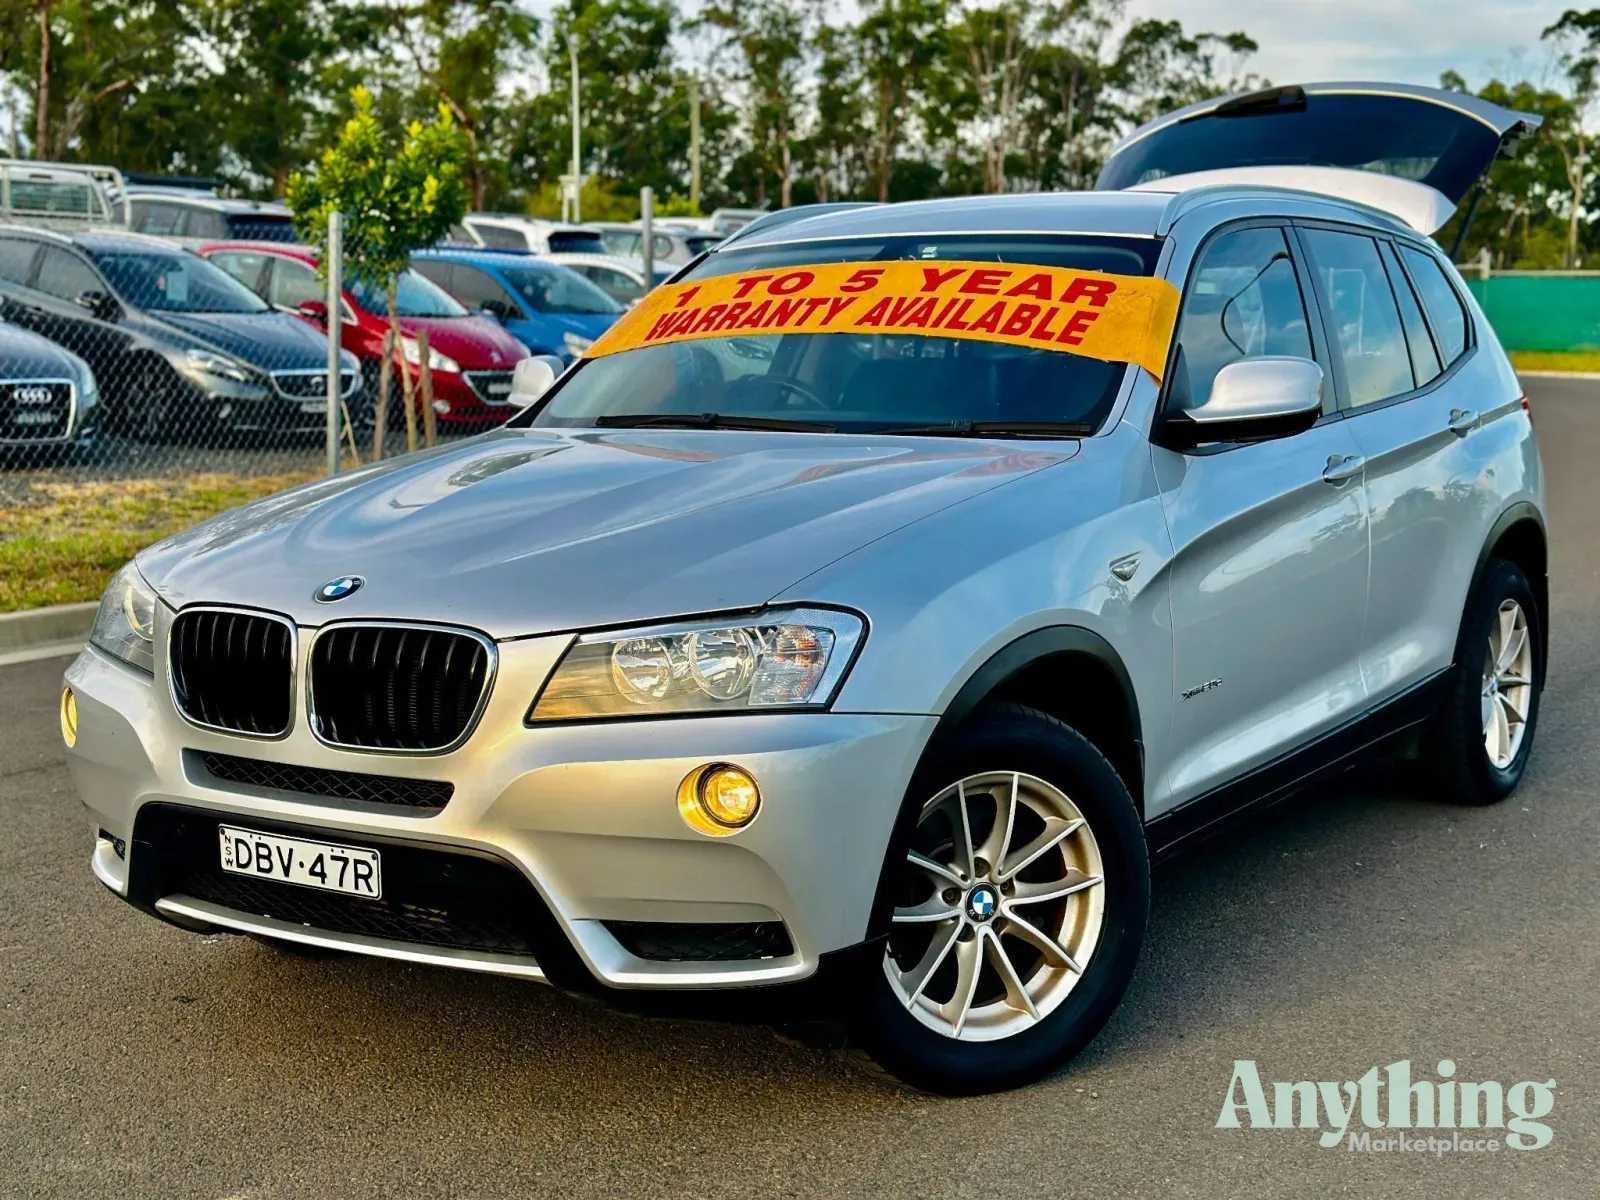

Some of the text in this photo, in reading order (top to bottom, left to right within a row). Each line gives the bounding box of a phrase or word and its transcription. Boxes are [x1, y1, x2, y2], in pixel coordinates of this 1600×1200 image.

[675, 268, 1118, 308] 1 TO 5 YEAR
[643, 296, 1100, 346] WARRANTY AVAILABLE
